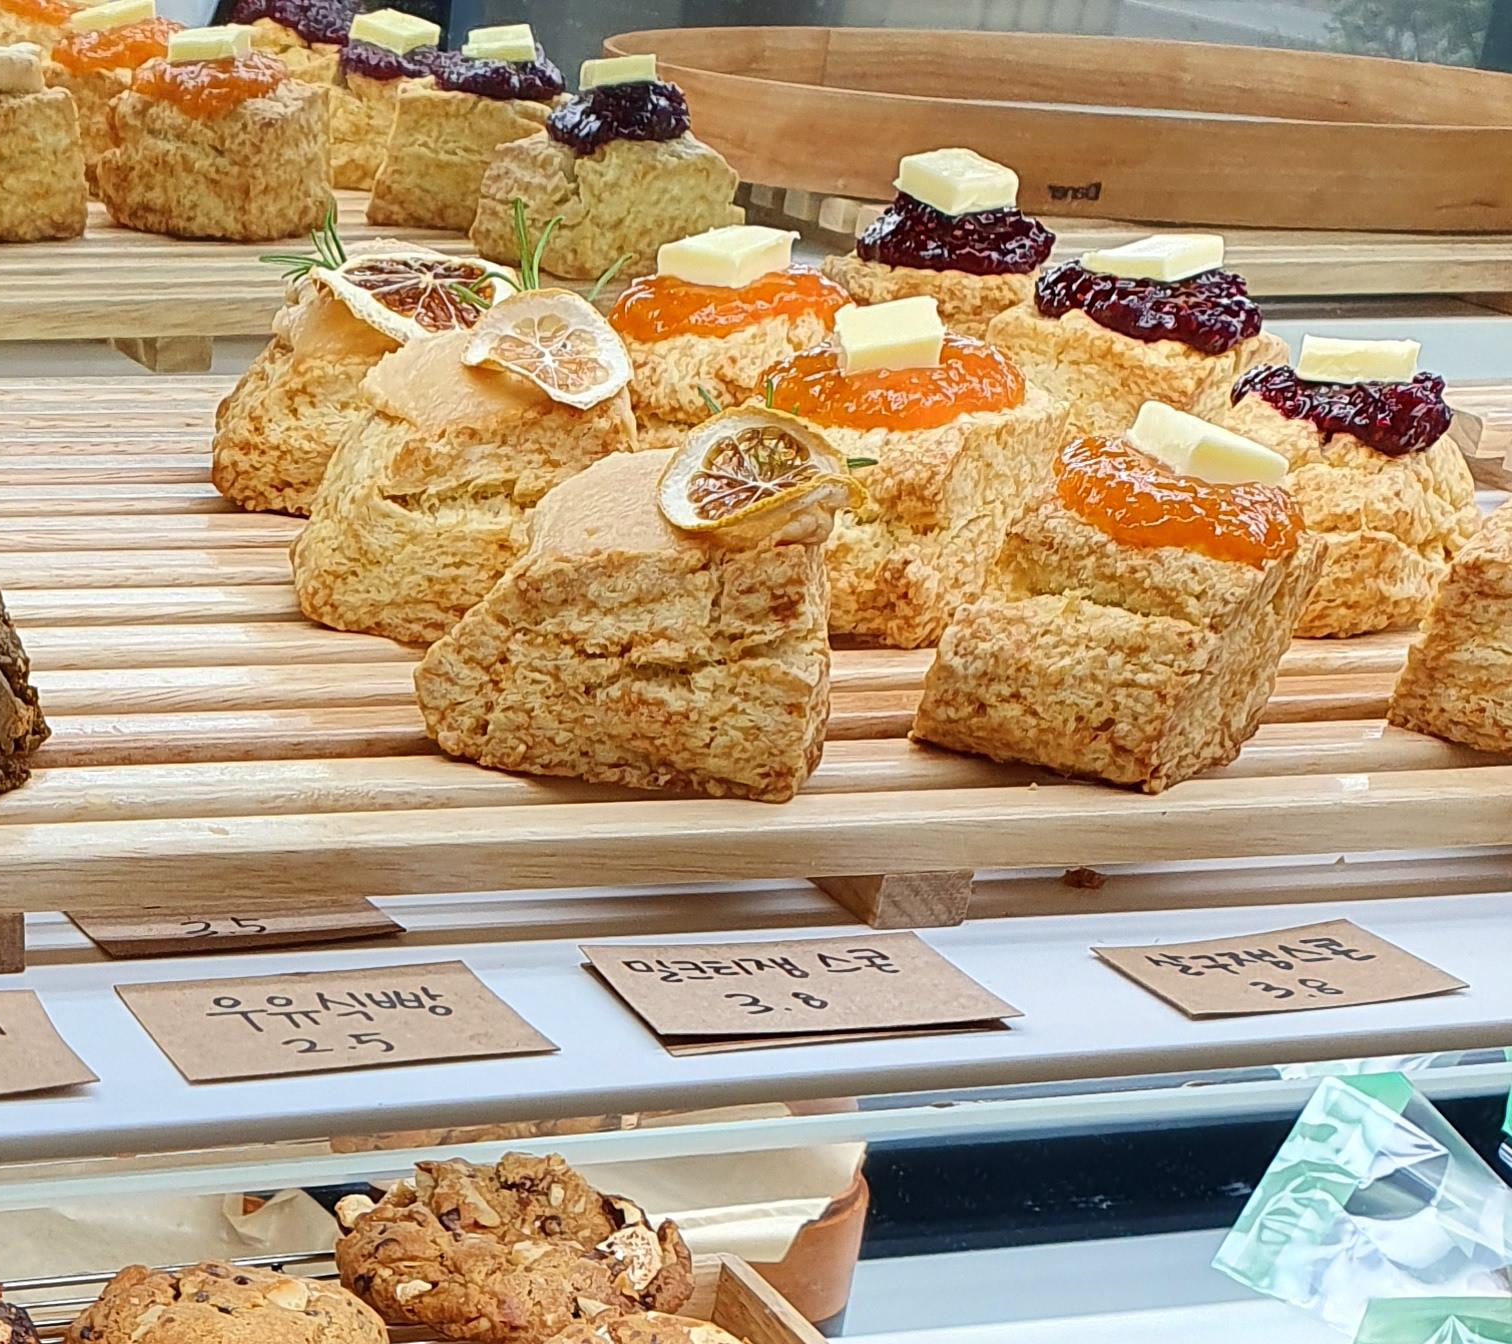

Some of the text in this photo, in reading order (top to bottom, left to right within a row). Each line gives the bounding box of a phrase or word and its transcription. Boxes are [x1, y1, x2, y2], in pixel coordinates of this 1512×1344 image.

[622, 948, 901, 983] 밀크티잼 스콘
[1248, 977, 1345, 1000] 3.8
[205, 986, 454, 1033] 우유식빵
[723, 990, 829, 1014] 3.8
[281, 1032, 395, 1054] 2.5
